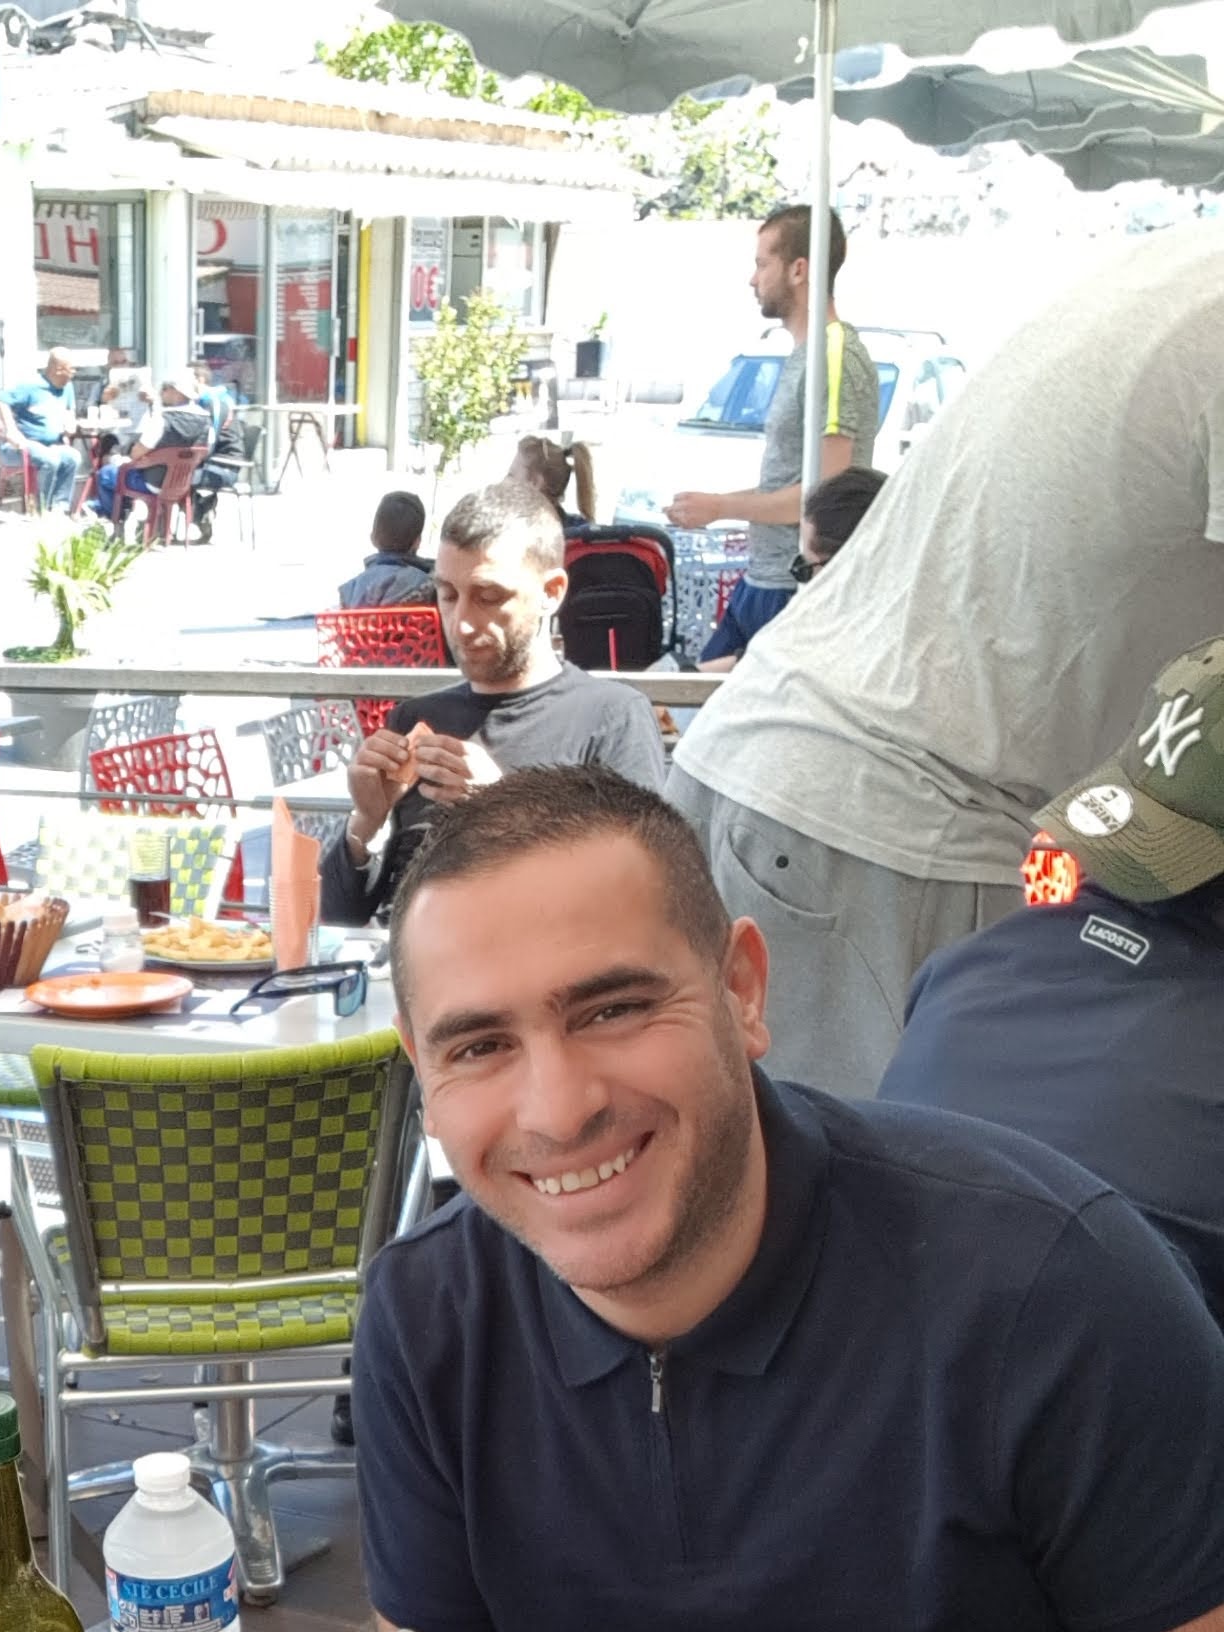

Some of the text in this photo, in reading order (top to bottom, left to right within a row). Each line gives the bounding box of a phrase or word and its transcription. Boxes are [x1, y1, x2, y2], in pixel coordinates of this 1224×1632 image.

[1088, 924, 1142, 955] LACOSTE
[122, 1575, 219, 1600] STE CECILE
